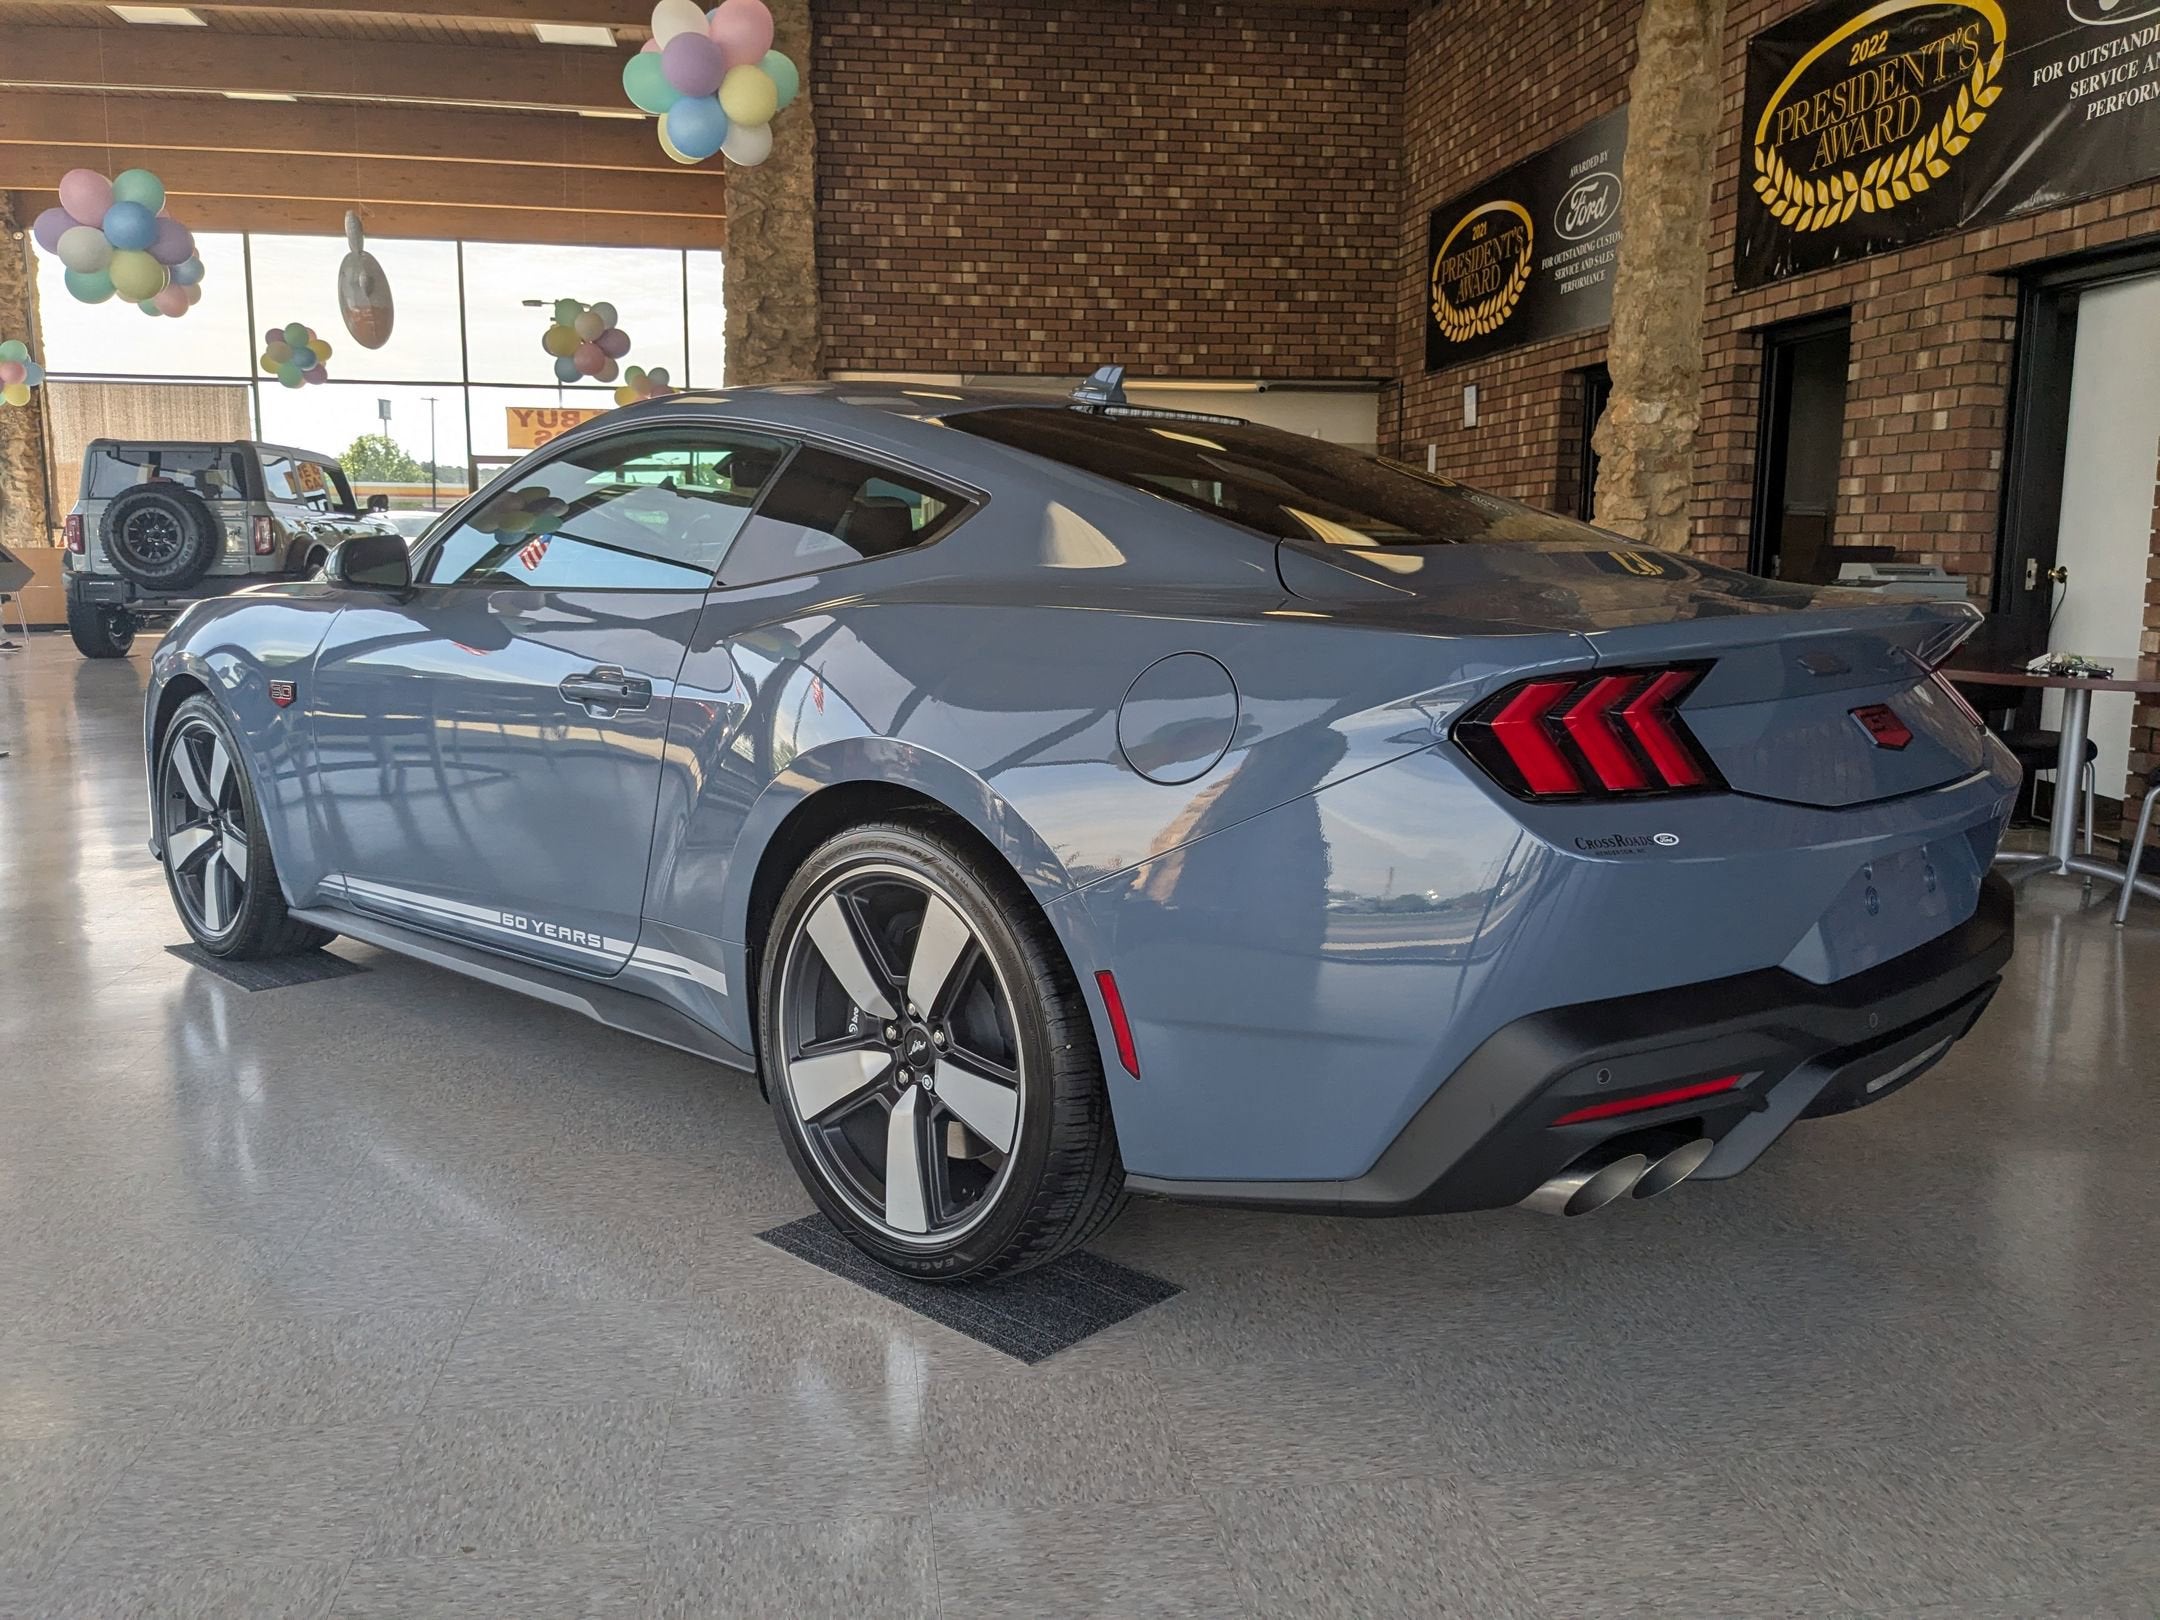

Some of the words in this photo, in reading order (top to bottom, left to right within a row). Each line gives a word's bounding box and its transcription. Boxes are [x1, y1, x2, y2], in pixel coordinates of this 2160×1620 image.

[1849, 30, 1889, 66] 2022
[1775, 22, 1980, 147] PRESIDENT'S
[2032, 61, 2063, 87] FOR
[2069, 60, 2139, 100] SERVICE
[1809, 94, 1921, 172] AWARD
[1565, 181, 1610, 232] Ford
[1440, 226, 1524, 286] PRESIDENT'S
[1541, 256, 1553, 270] FOR
[1554, 240, 1595, 265] OUTSTANDING
[1554, 262, 1579, 280] SERVICE
[1581, 257, 1594, 271] AND
[1594, 249, 1614, 266] SALES
[1456, 264, 1501, 304] AWARD
[1560, 269, 1606, 295] PERFORMANCE
[502, 912, 527, 930] 60
[531, 919, 601, 948] YEARS
